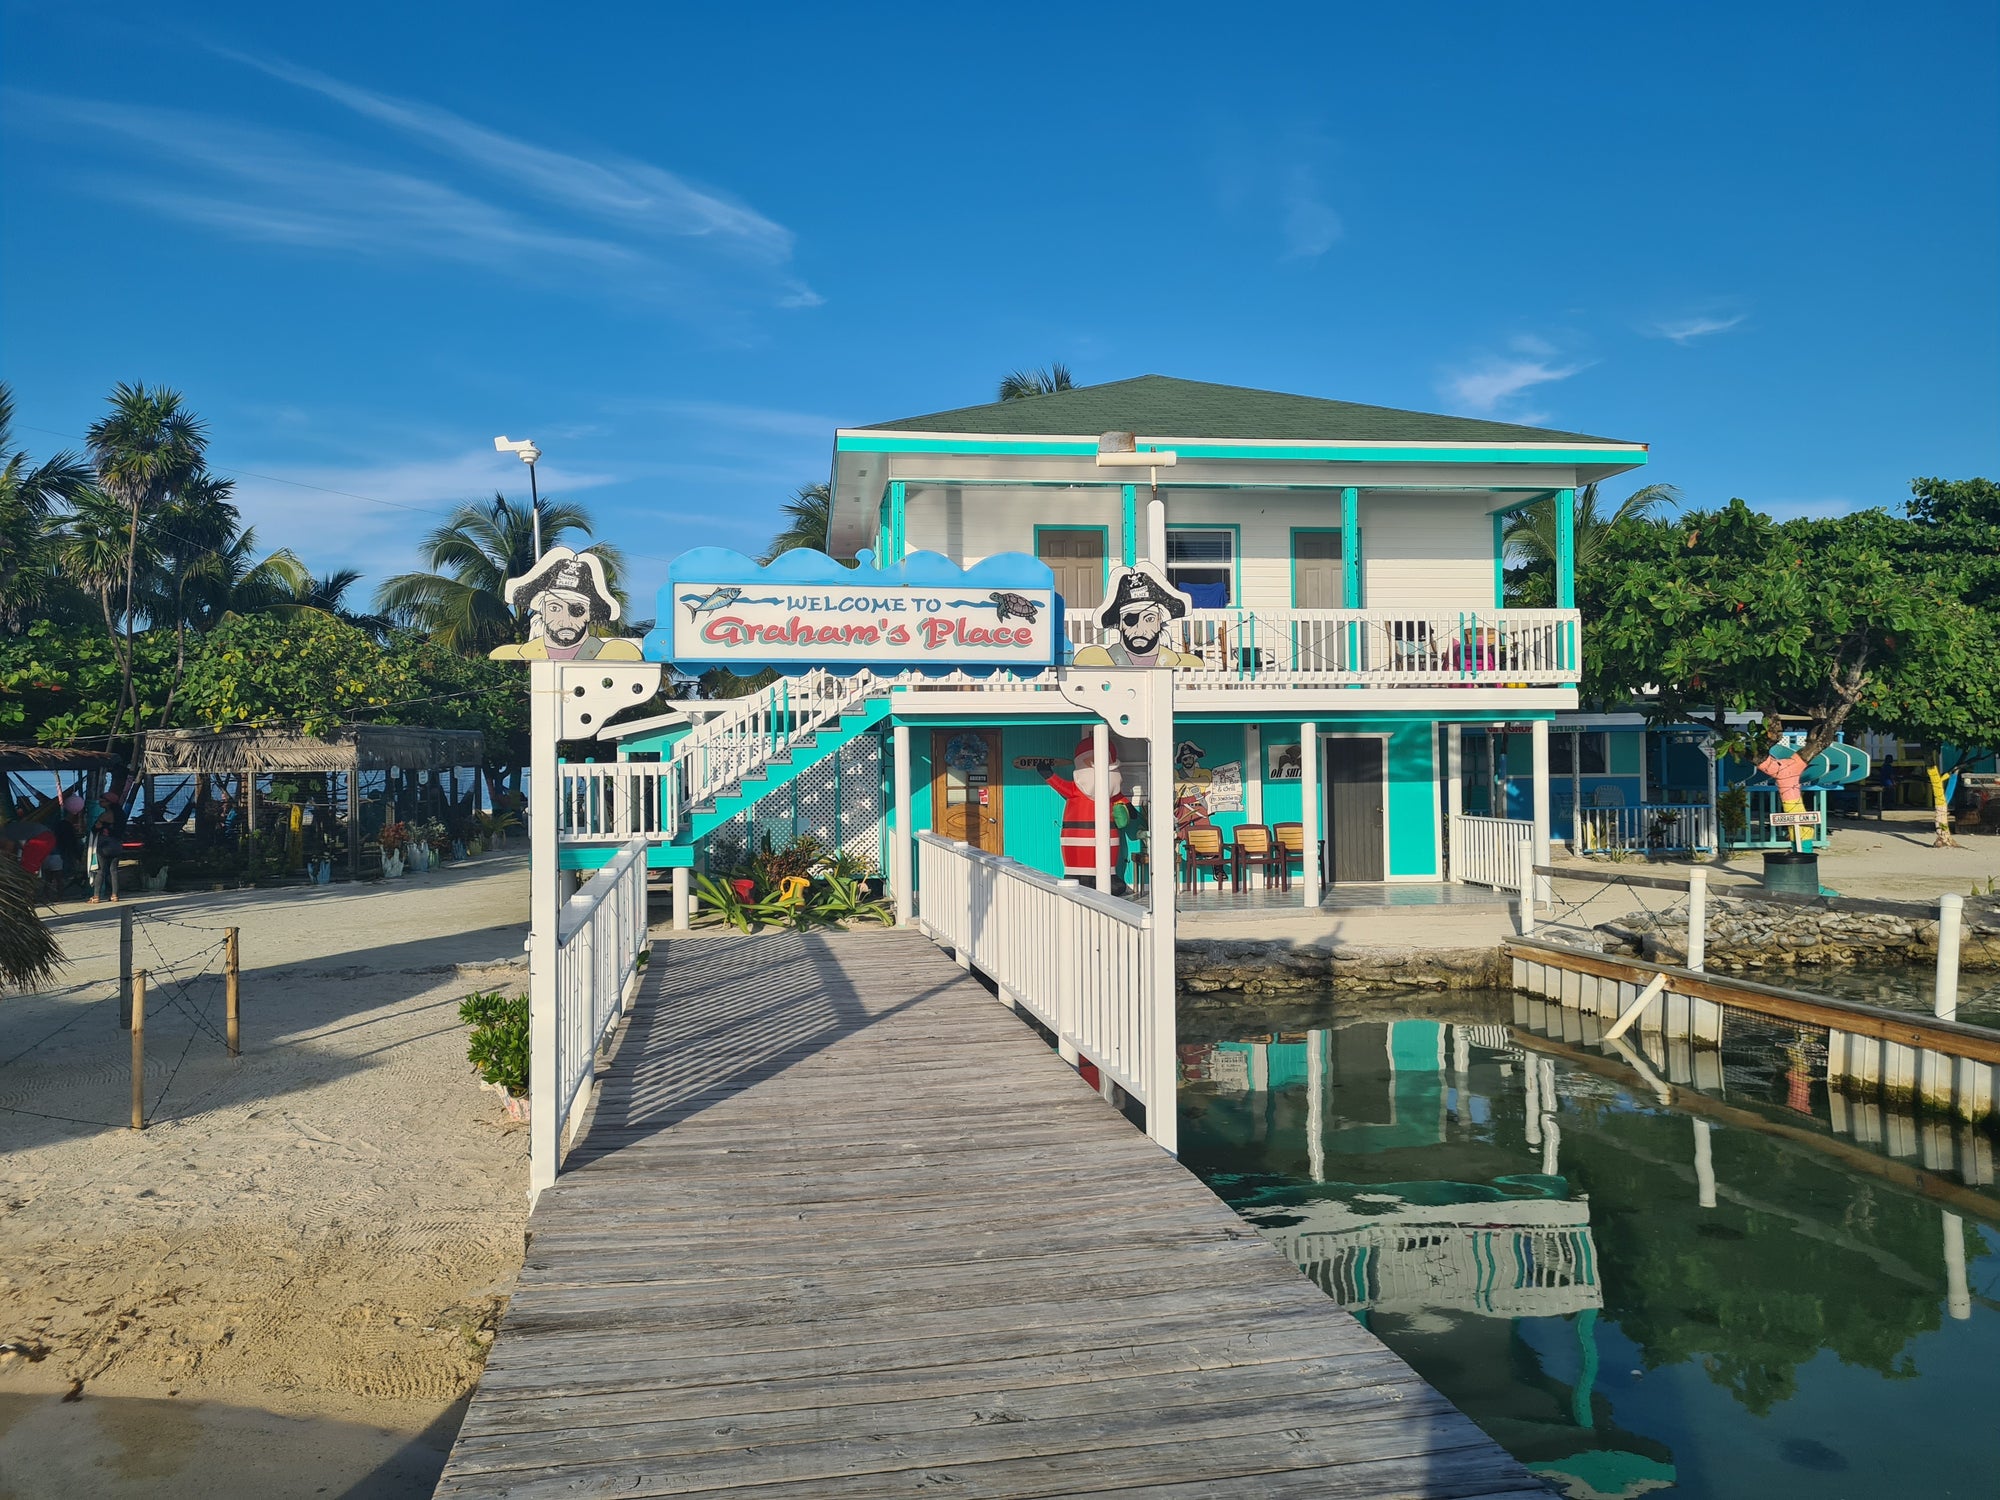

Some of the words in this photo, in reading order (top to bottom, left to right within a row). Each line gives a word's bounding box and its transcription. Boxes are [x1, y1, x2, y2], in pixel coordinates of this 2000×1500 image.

[787, 595, 907, 613] WELCOME
[911, 598, 942, 613] TO
[701, 616, 911, 648] Graham's
[916, 616, 1034, 650] Place
[1271, 769, 1283, 778] OH
